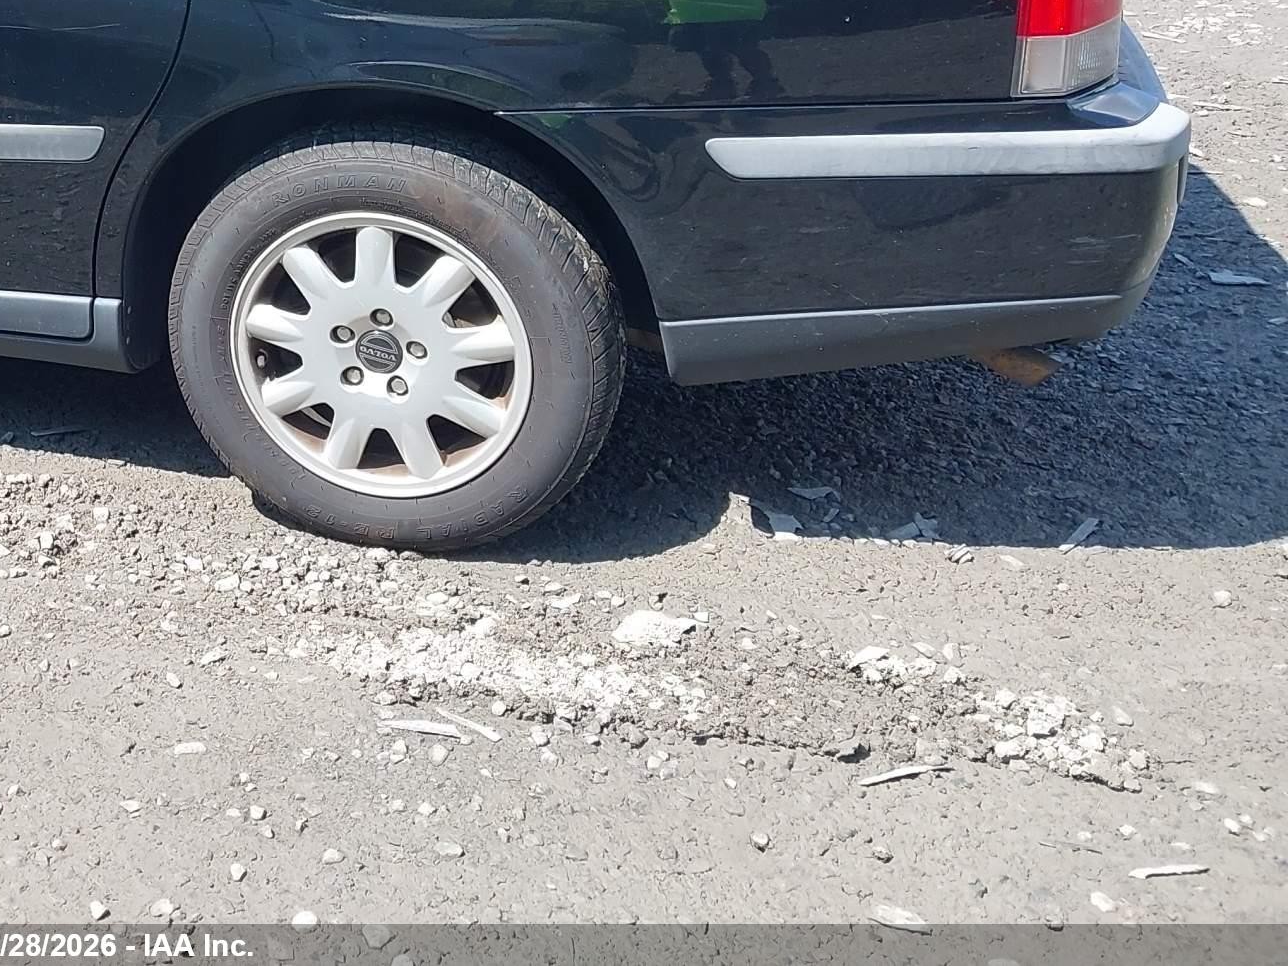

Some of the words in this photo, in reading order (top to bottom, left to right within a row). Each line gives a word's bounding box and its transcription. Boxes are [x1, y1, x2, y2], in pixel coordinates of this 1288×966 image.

[260, 174, 406, 215] RONMAN
[360, 346, 396, 361] VOLVO
[416, 485, 528, 539] RADIAL
